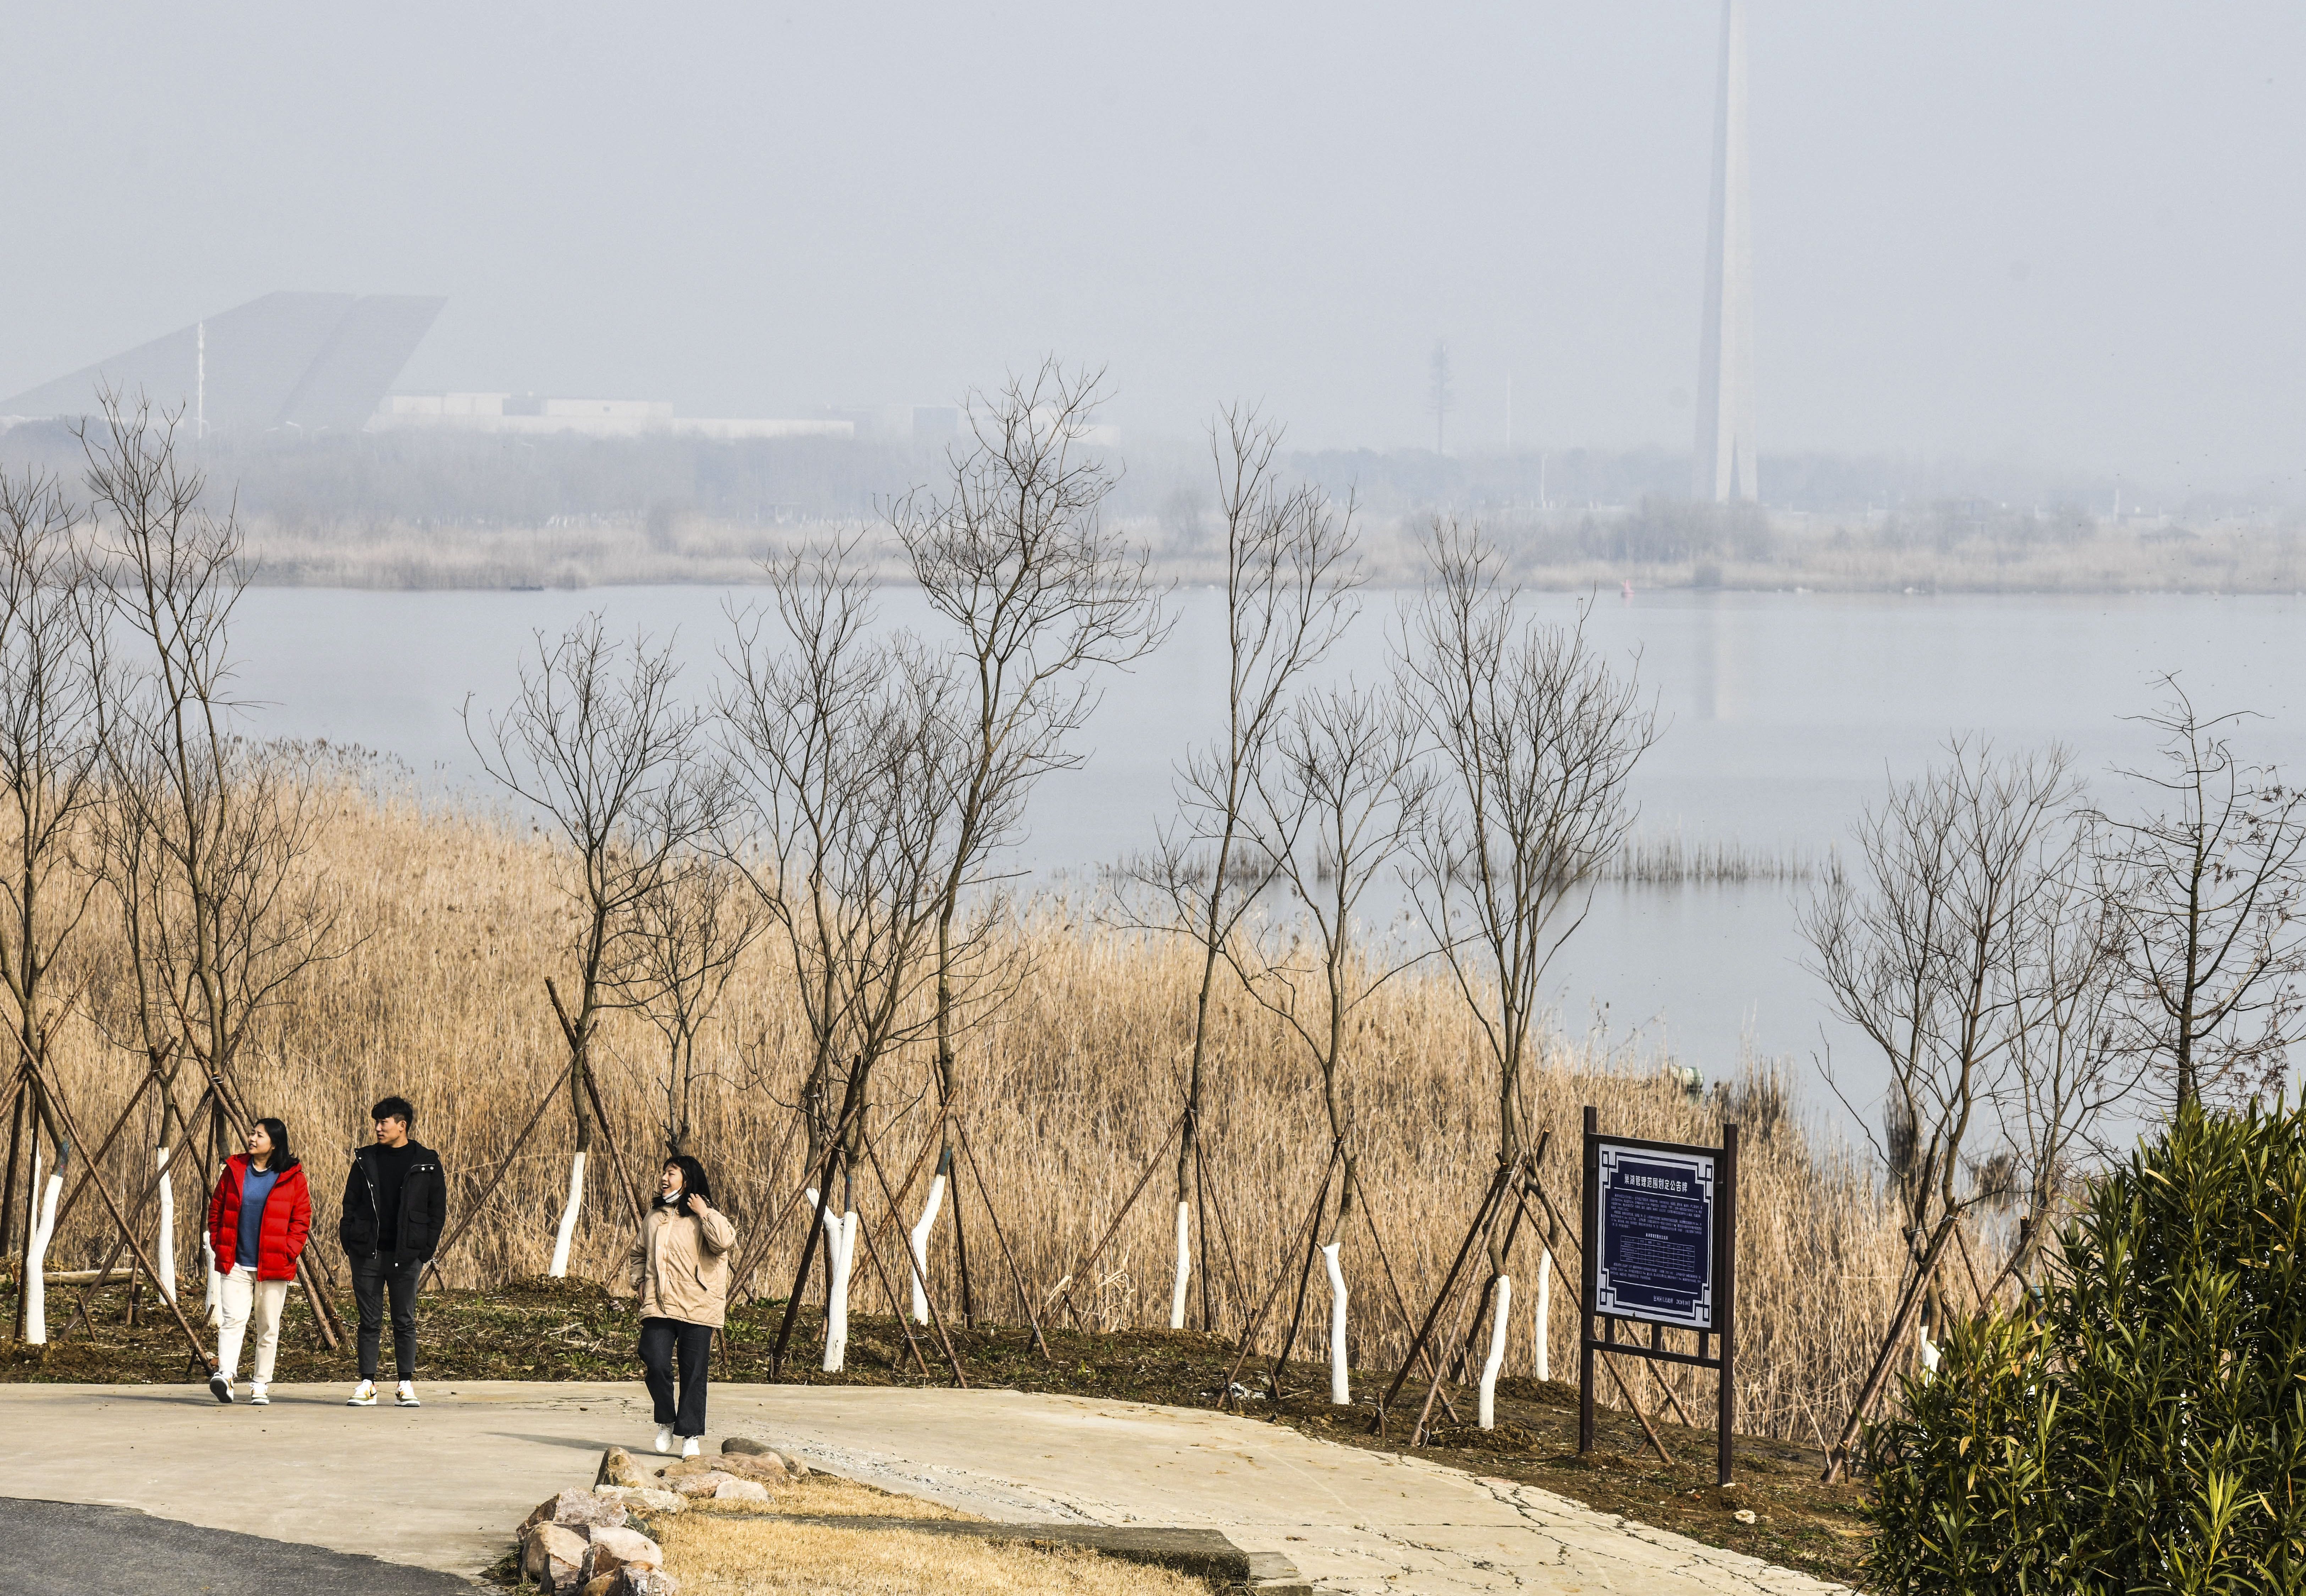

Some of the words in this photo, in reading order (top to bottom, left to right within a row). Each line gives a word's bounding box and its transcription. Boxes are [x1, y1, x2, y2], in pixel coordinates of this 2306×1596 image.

[1624, 1173, 1688, 1193] 巢湖管理范围划定公告牌
